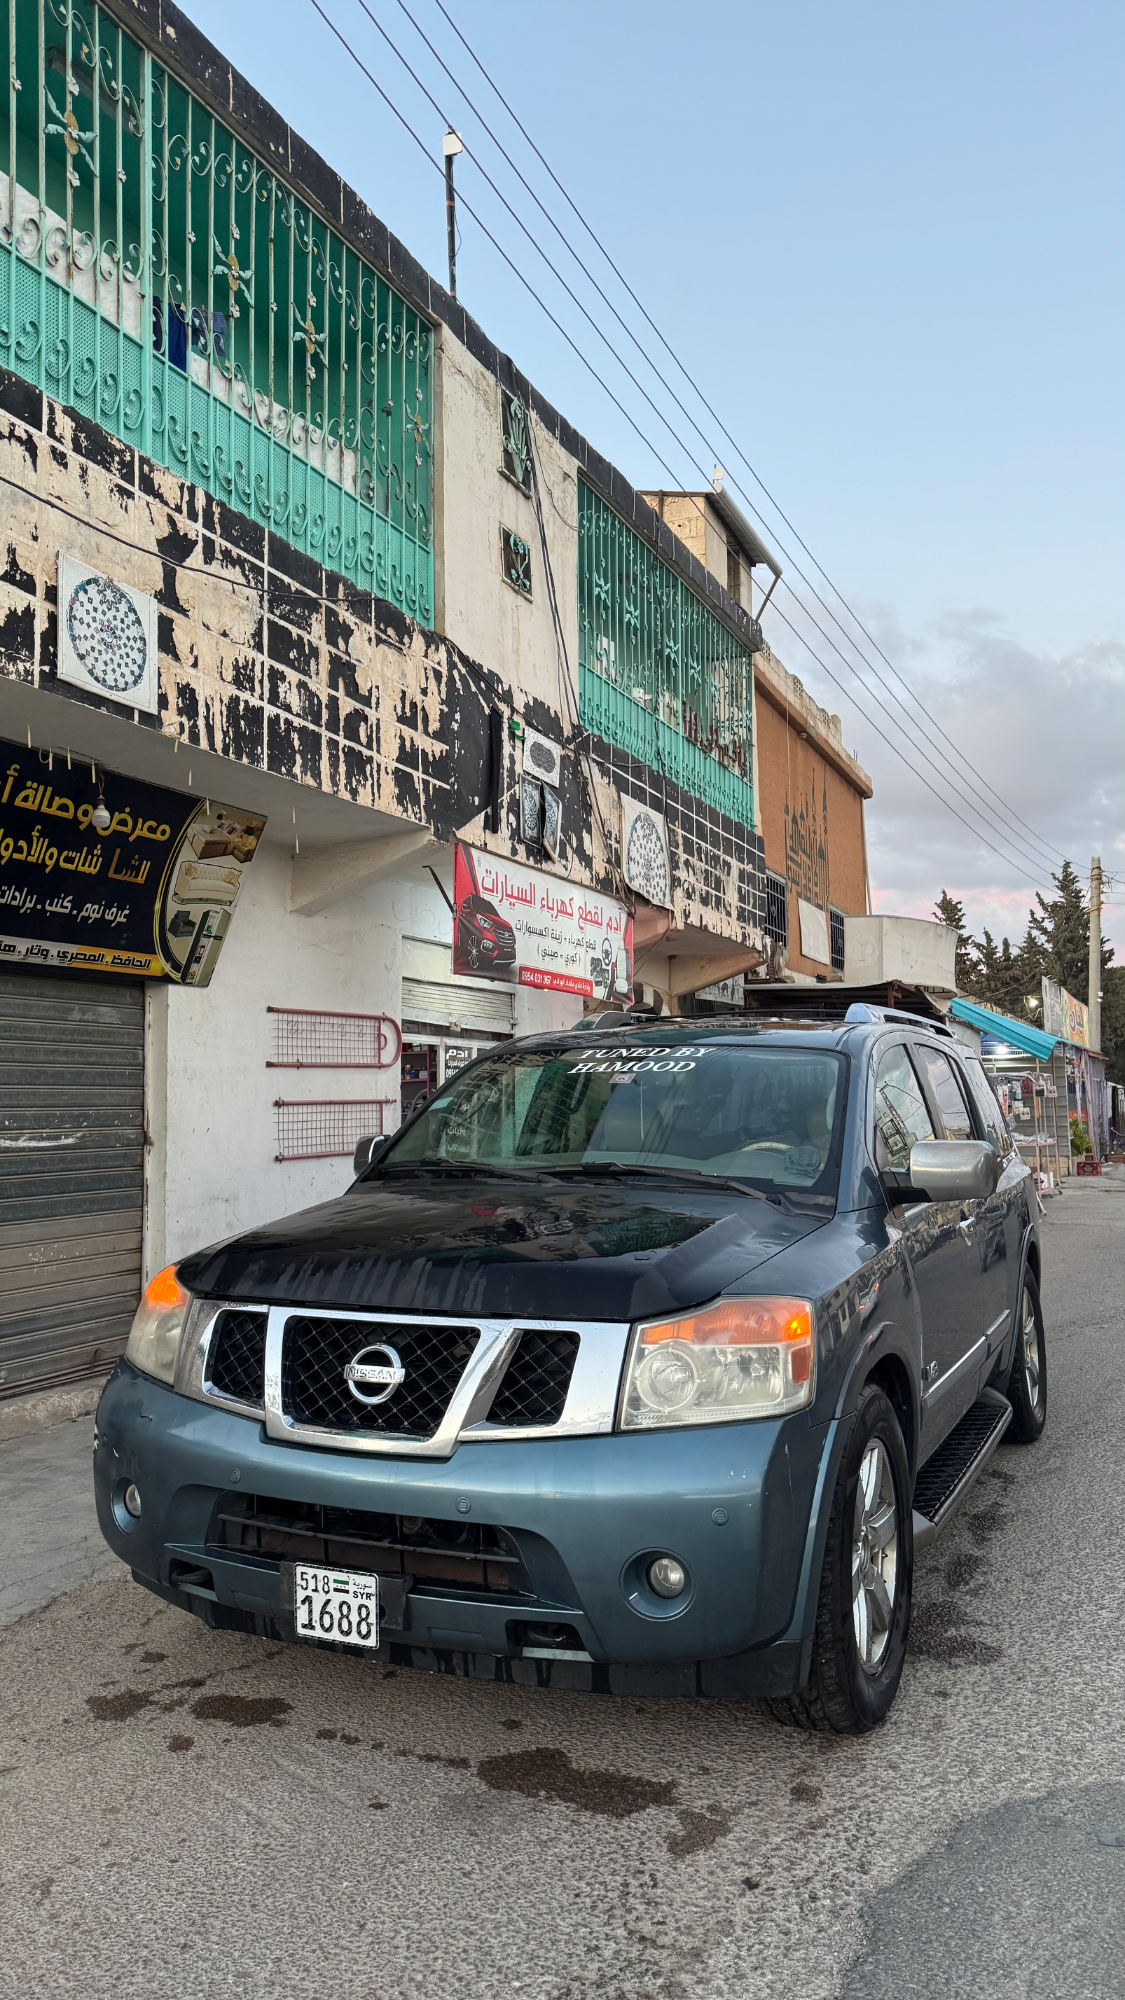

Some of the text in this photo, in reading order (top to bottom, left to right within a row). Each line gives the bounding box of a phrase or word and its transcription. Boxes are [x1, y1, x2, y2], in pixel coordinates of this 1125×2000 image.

[14, 781, 93, 831] وصالة
[96, 807, 171, 842] معرض
[45, 893, 73, 916] كنب
[481, 868, 623, 935] آدم لقطع كهرباء السيارات
[77, 900, 105, 924] نوم
[104, 904, 130, 928] غرف
[568, 933, 584, 949] كهرباء
[585, 939, 597, 953] قطع
[56, 948, 106, 966] المصري
[110, 954, 151, 970] الحافظ
[577, 1047, 717, 1059] TUNED BY
[567, 1061, 697, 1074] HAMOOD
[346, 1365, 397, 1381] NISSAN
[300, 1571, 331, 1595] 518
[352, 1590, 373, 1601] SYR
[301, 1595, 372, 1640] 1688
